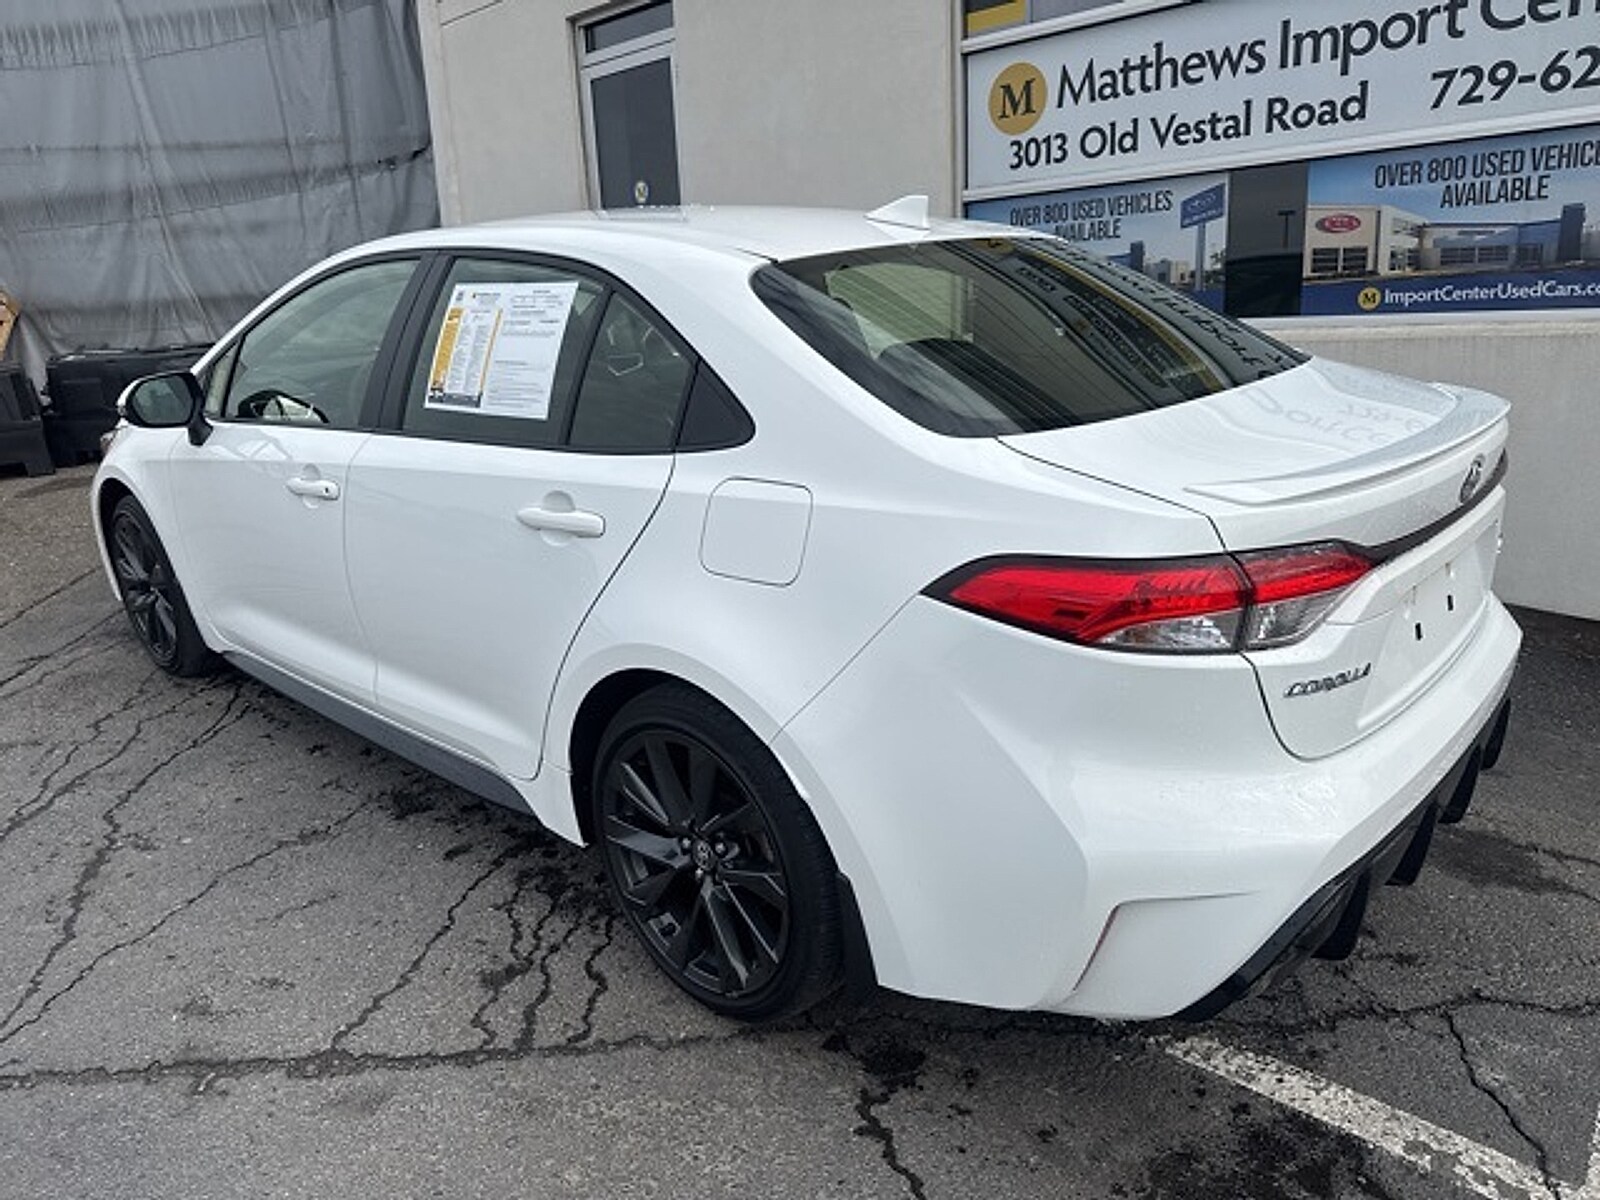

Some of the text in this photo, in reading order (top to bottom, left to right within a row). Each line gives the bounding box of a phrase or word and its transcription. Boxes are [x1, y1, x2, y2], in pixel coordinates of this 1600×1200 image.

[1056, 39, 1267, 108] Matthews
[1279, 0, 1468, 76] Import
[998, 77, 1036, 120] M
[1430, 45, 1600, 111] 729-62
[1009, 79, 1369, 170] 3013 Old Vestal Road
[1374, 161, 1422, 188] OVER
[1427, 155, 1466, 183] 800
[1472, 150, 1525, 178] USED
[1010, 205, 1041, 227] OVER
[1043, 202, 1069, 224] 800
[1072, 197, 1106, 221] USED
[1107, 190, 1173, 216] VEHICLES
[1440, 174, 1551, 209] AVAILABLE
